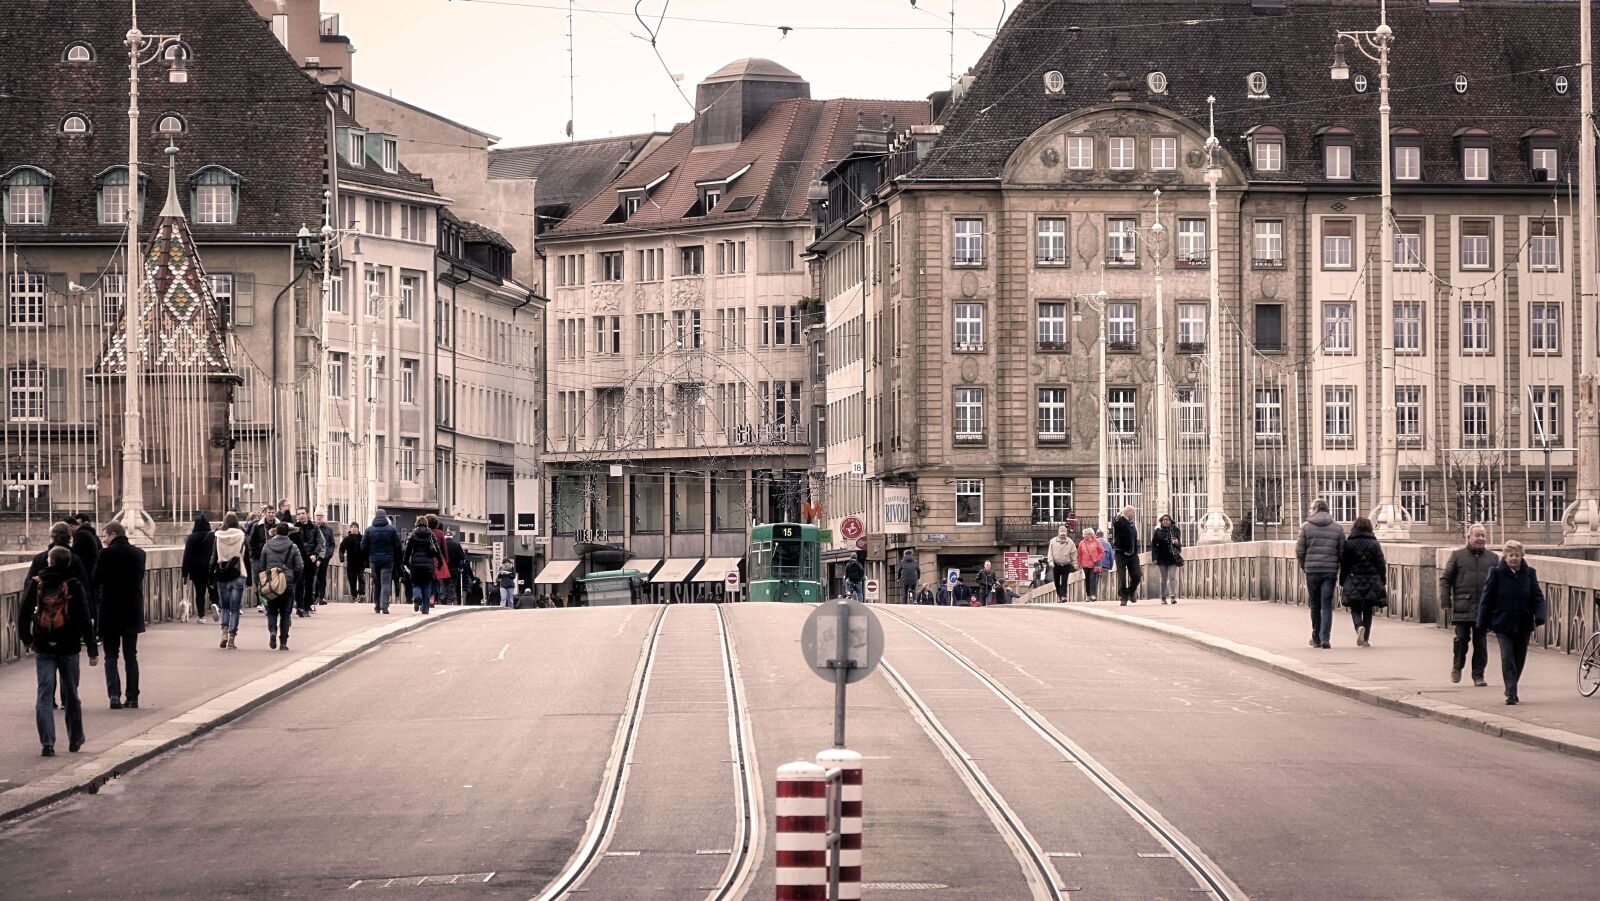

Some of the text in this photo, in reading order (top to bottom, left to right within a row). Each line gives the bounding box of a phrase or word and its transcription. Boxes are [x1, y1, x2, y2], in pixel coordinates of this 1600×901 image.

[853, 463, 862, 472] 18
[885, 495, 909, 503] COIFFURE
[885, 504, 909, 523] RIVOLI
[783, 527, 793, 537] 15
